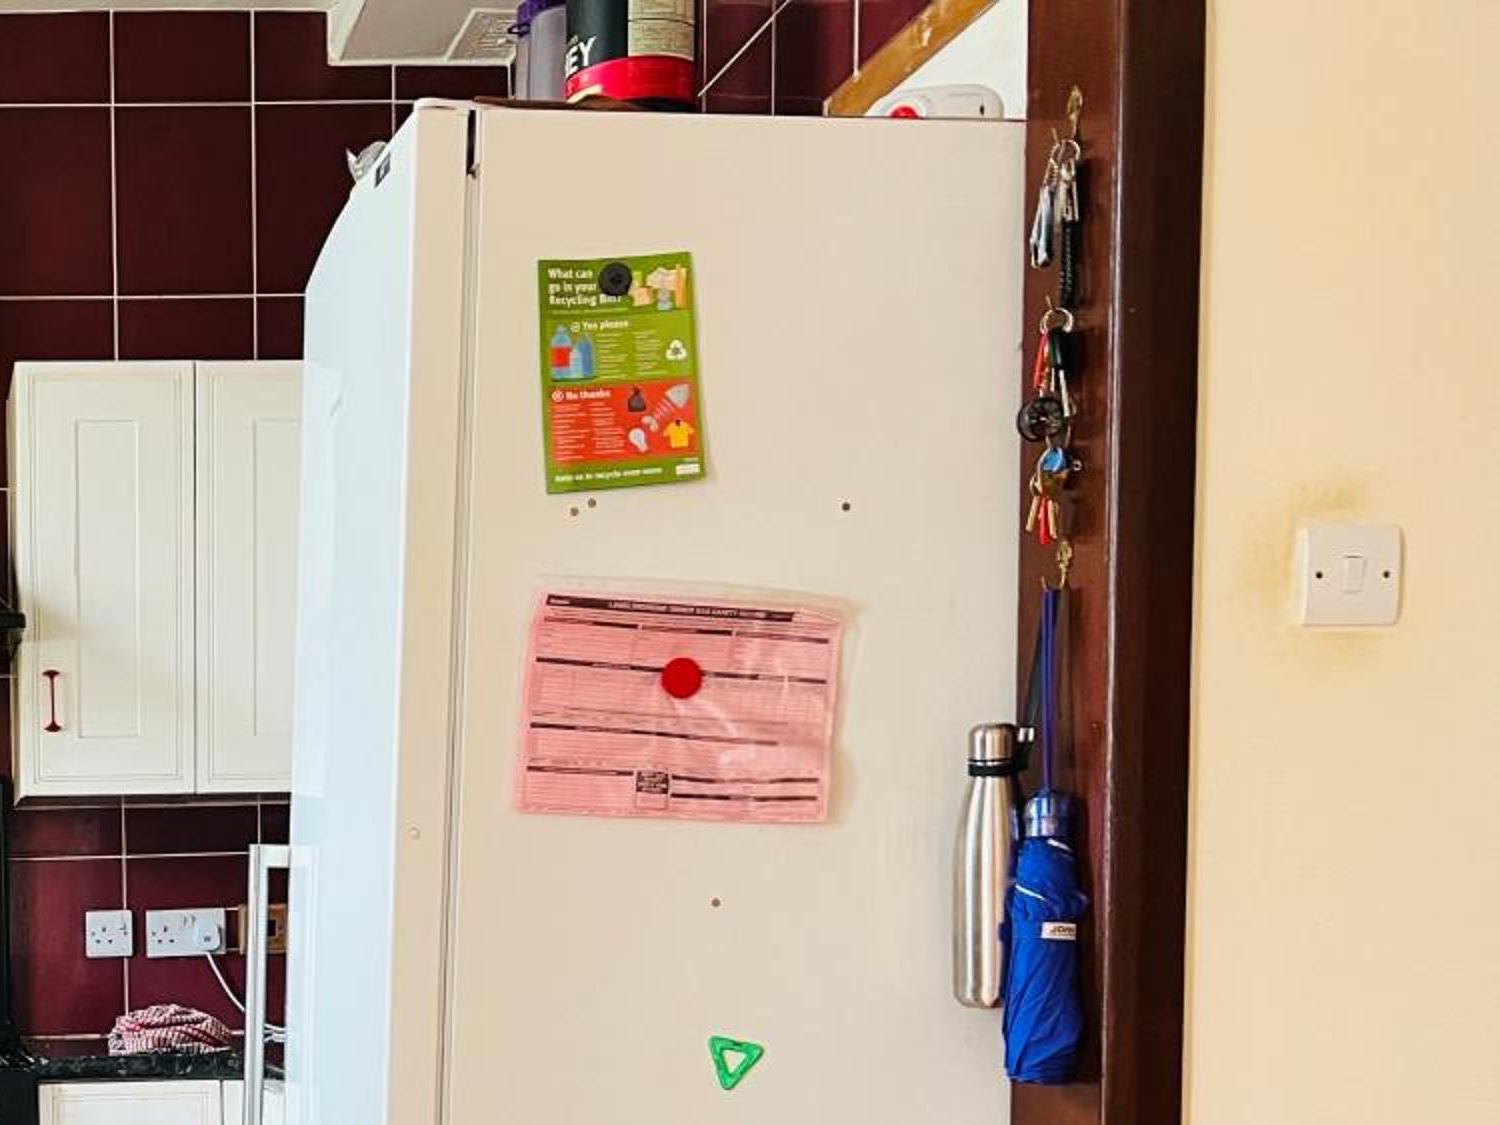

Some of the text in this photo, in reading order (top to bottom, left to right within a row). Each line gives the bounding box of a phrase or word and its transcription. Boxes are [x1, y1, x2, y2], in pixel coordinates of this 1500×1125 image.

[548, 268, 593, 279] What can
[548, 281, 597, 295] go in your
[549, 294, 597, 308] Recycling
[582, 320, 598, 330] Yes
